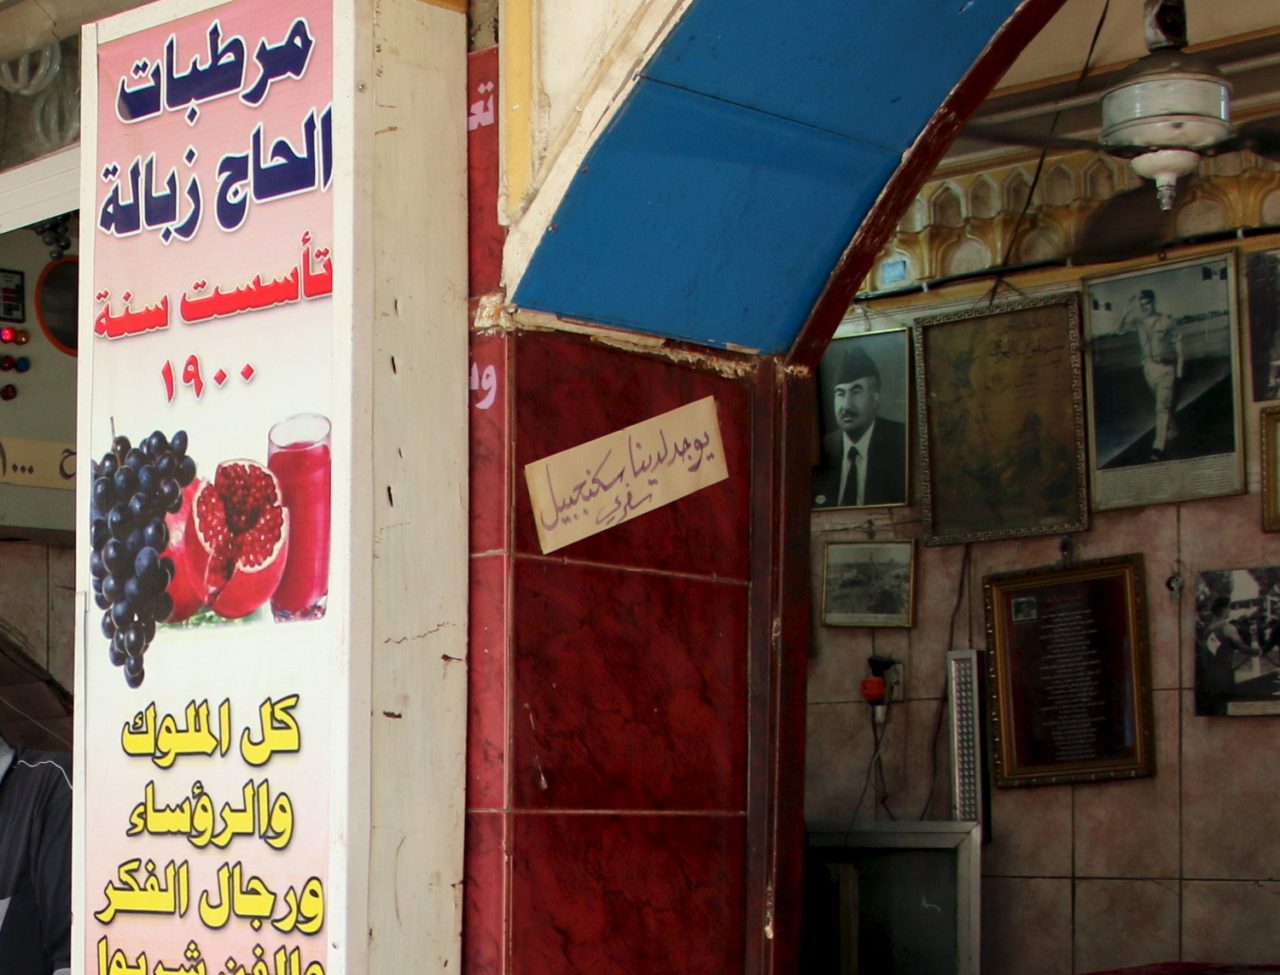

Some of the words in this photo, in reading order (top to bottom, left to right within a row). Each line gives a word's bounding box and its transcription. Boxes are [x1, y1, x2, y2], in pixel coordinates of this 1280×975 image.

[116, 15, 315, 124] مرطبات
[98, 143, 201, 243] زبالة
[216, 104, 332, 231] الحاج
[179, 231, 332, 323] تأسست
[93, 290, 170, 340] سنة
[160, 354, 255, 404] ١٩٠٠
[628, 429, 669, 487] لدينا
[669, 430, 715, 473] يوجد
[540, 448, 625, 532] سكنجبيل
[121, 698, 230, 769] الملوك
[240, 693, 301, 767] كل
[127, 779, 295, 850] والرؤساء
[94, 858, 190, 924] الفكر
[199, 862, 326, 935] ورجال
